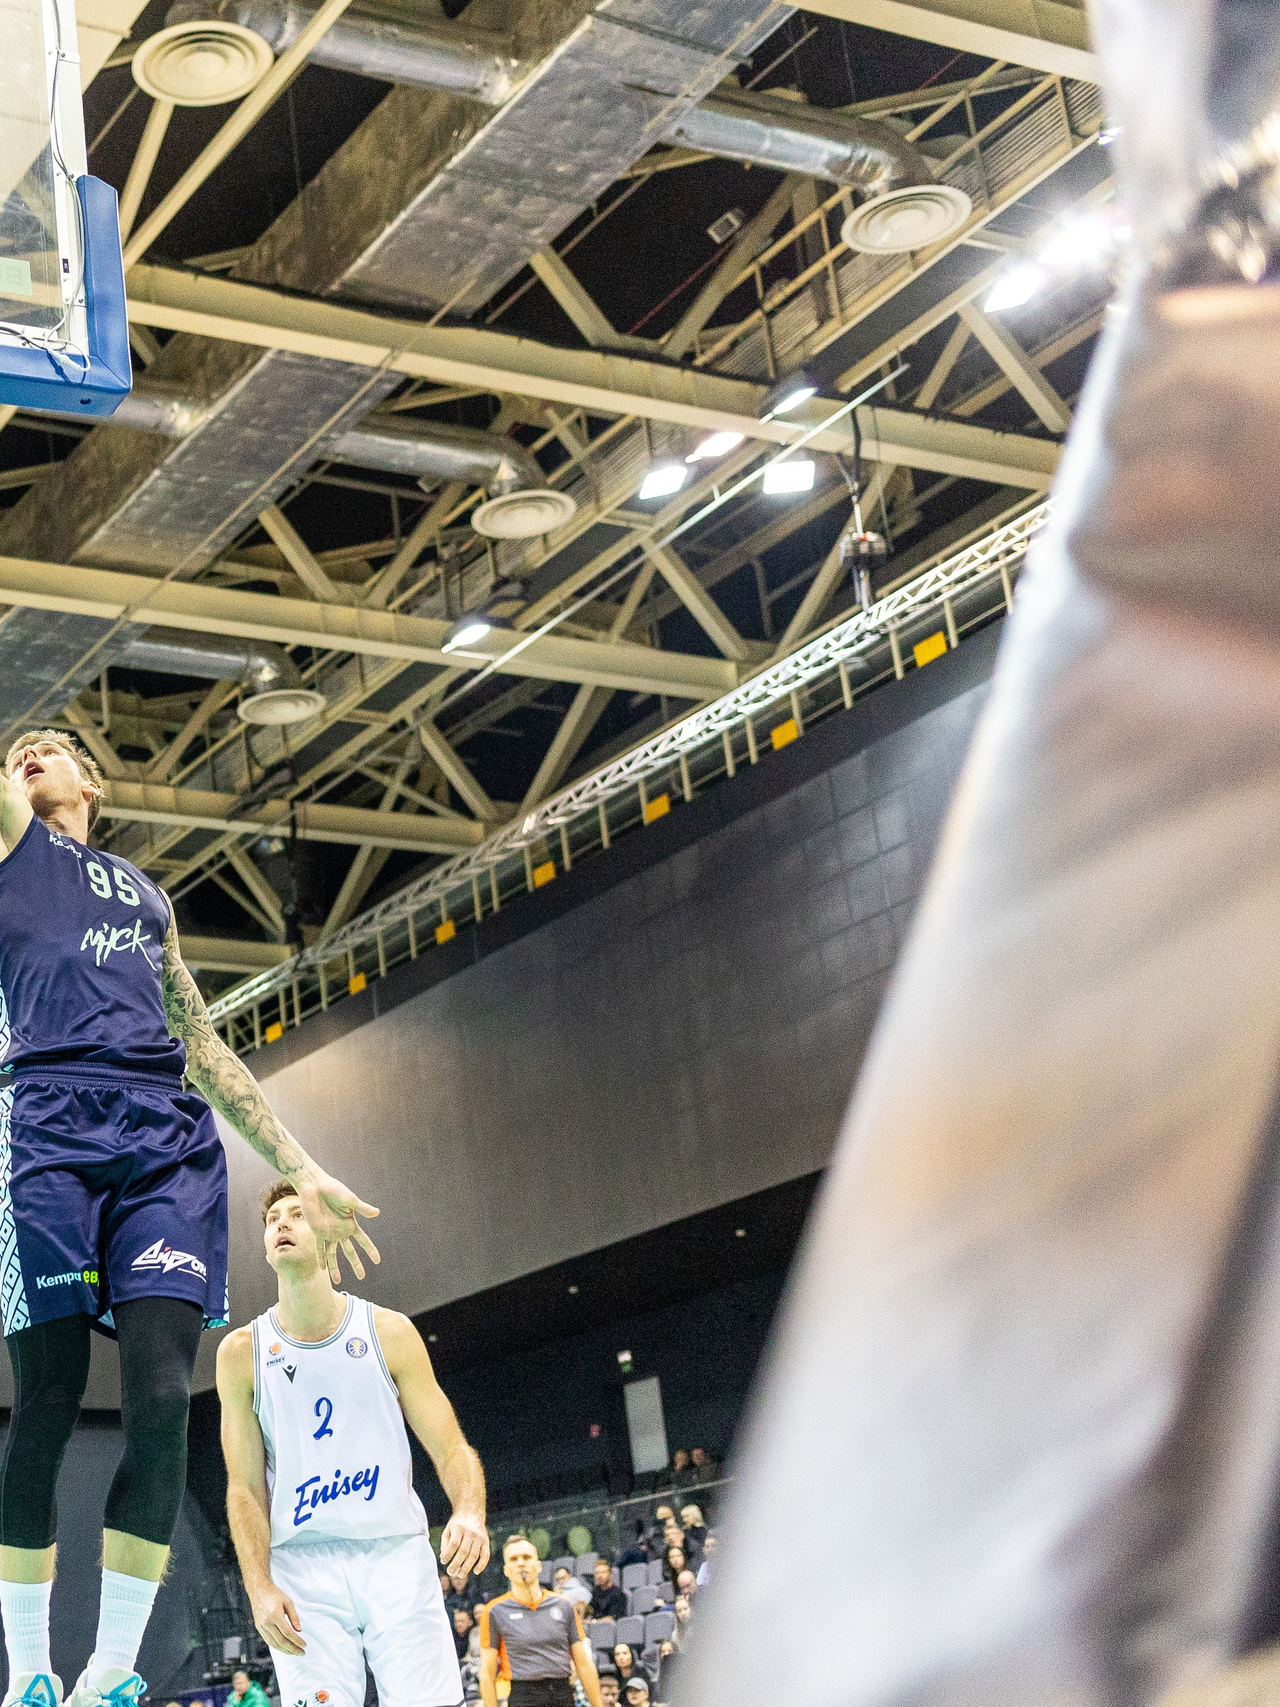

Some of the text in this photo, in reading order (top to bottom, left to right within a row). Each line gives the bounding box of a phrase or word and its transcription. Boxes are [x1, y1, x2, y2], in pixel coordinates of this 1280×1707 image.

[86, 861, 140, 907] 95
[36, 1271, 82, 1290] Kempa
[266, 1357, 285, 1367] ENISEY
[313, 1396, 333, 1441] 2
[293, 1464, 380, 1527] Enisey
